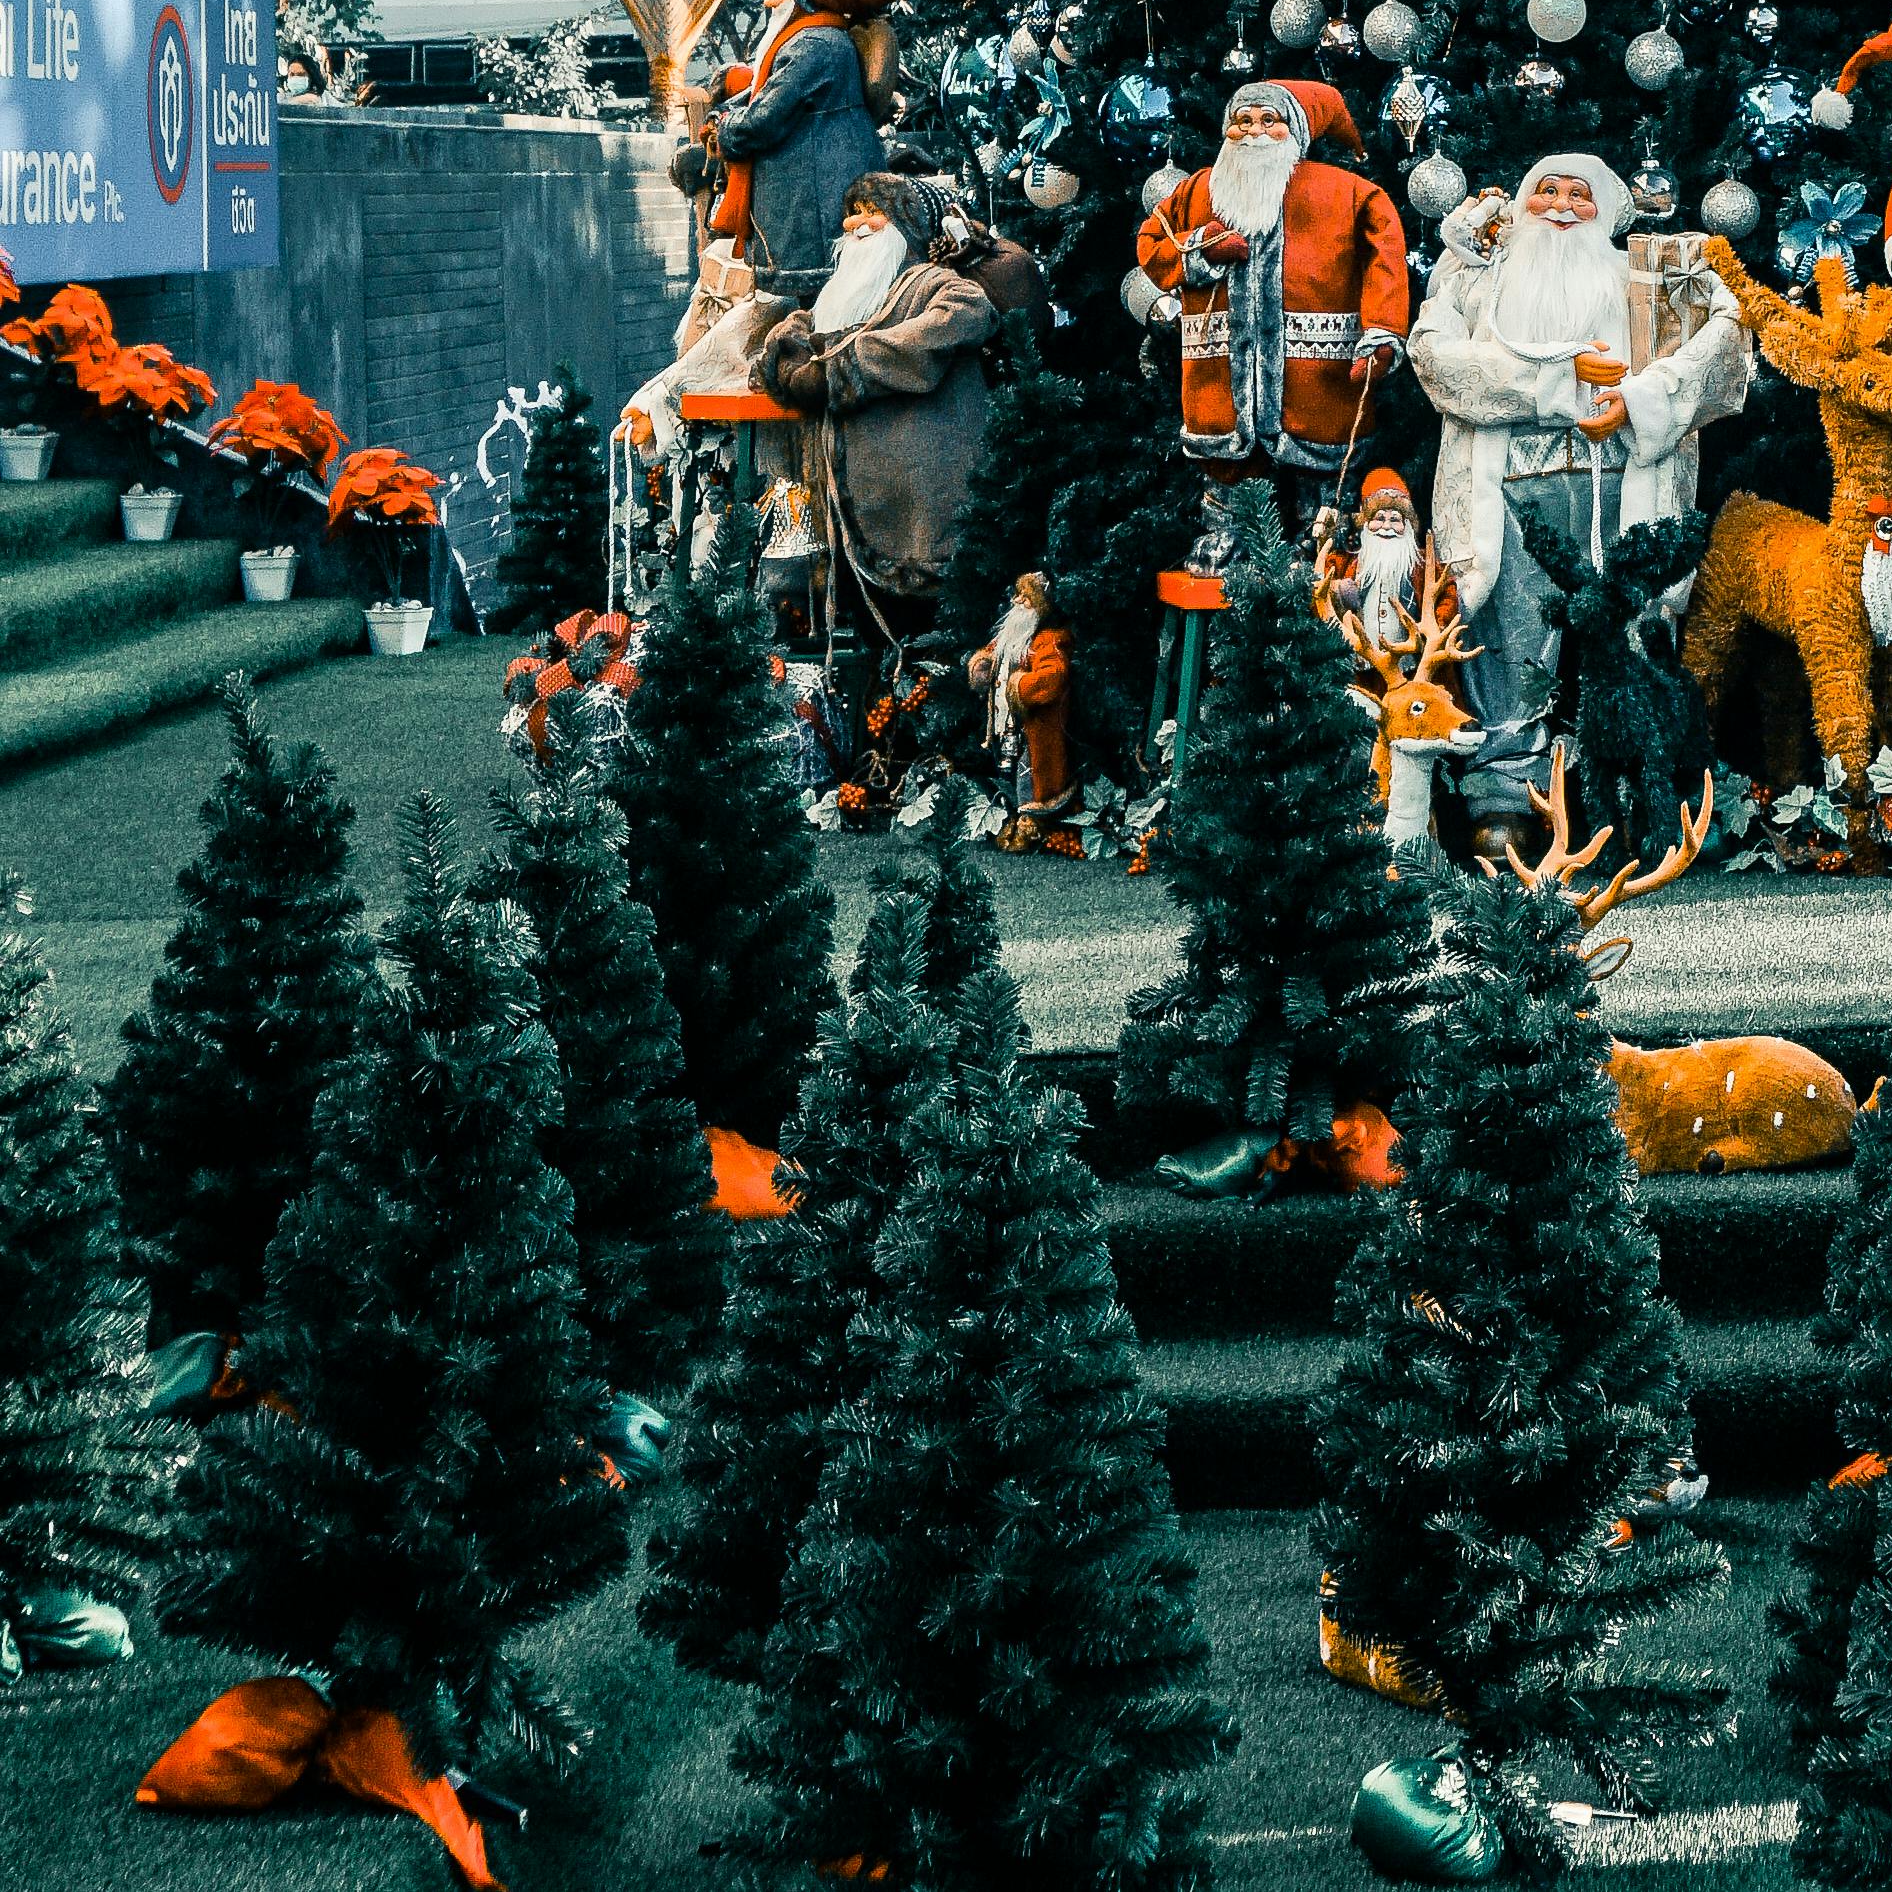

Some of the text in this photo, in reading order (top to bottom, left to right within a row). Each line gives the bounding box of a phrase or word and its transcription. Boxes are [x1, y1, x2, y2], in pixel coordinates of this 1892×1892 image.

[213, 72, 270, 146] ประกัน
[231, 184, 255, 234] ชีวิต
